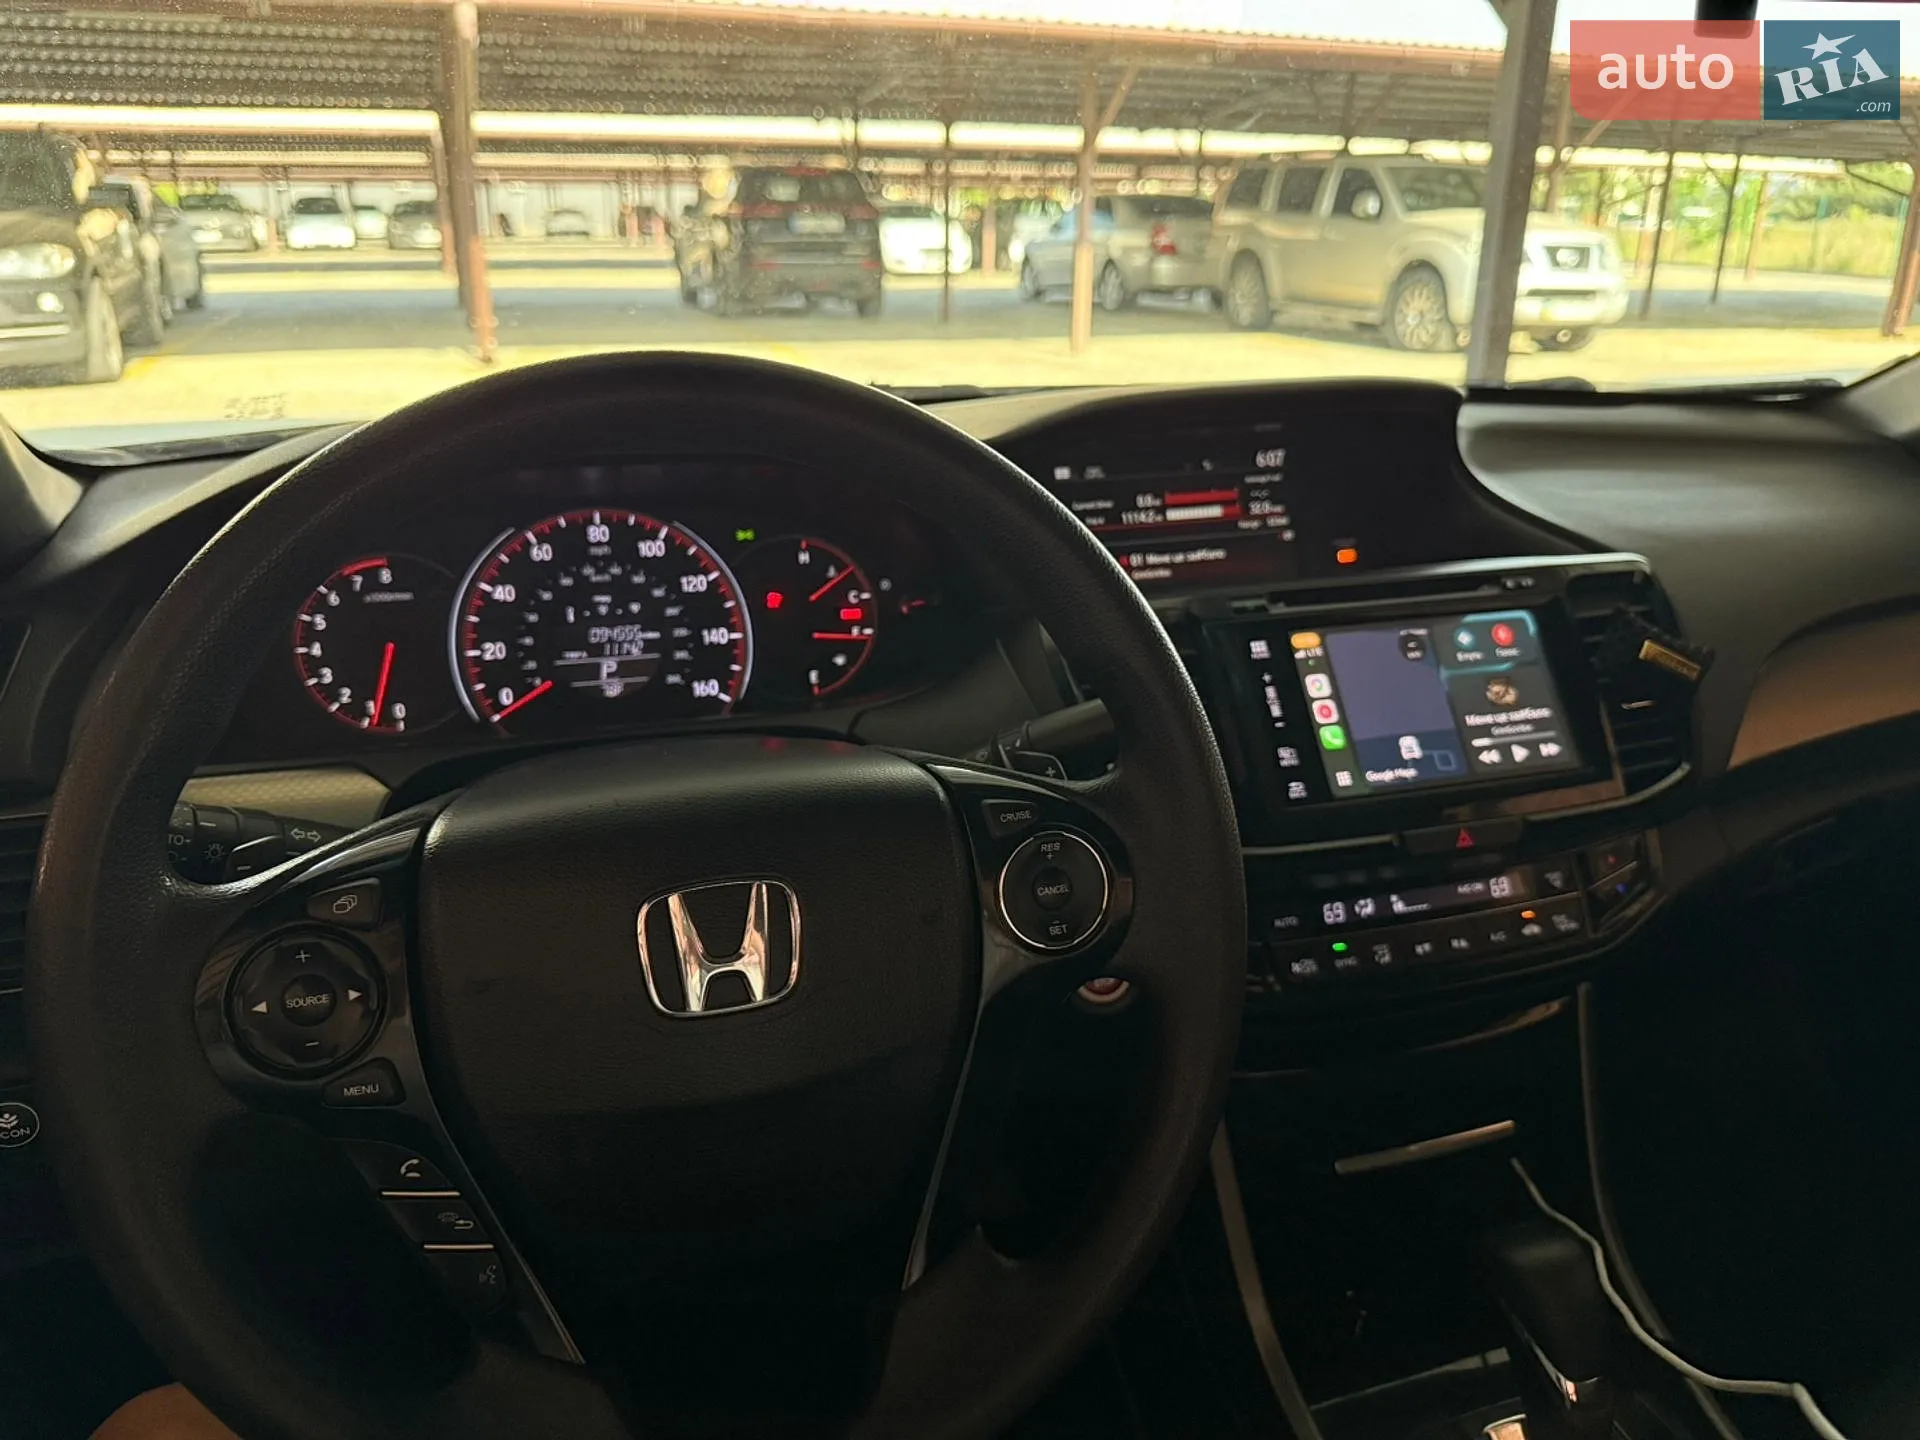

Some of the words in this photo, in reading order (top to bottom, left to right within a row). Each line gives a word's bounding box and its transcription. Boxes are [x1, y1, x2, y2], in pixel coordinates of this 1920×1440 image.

[586, 524, 610, 543] 80
[530, 543, 553, 561] 60
[638, 540, 666, 557] 100
[352, 574, 363, 592] 7
[378, 567, 392, 584] 8
[680, 575, 708, 593] 120
[326, 590, 340, 606] 6
[491, 584, 515, 602] 40
[312, 613, 326, 630] 5
[702, 627, 729, 645] 140
[309, 640, 323, 658] 4
[481, 641, 506, 661] 20
[319, 666, 333, 684] 3
[601, 659, 618, 681] P
[338, 686, 352, 704] 2
[498, 686, 514, 706] 0
[692, 680, 719, 698] 160
[391, 702, 406, 719] 0
[1000, 810, 1032, 823] CRUISE
[1041, 842, 1061, 852] RES
[1036, 884, 1070, 897] CANCEL
[1323, 901, 1346, 925] 69
[1049, 924, 1068, 936] SET
[286, 993, 329, 1009] SOURCE
[343, 1083, 379, 1096] MENU
